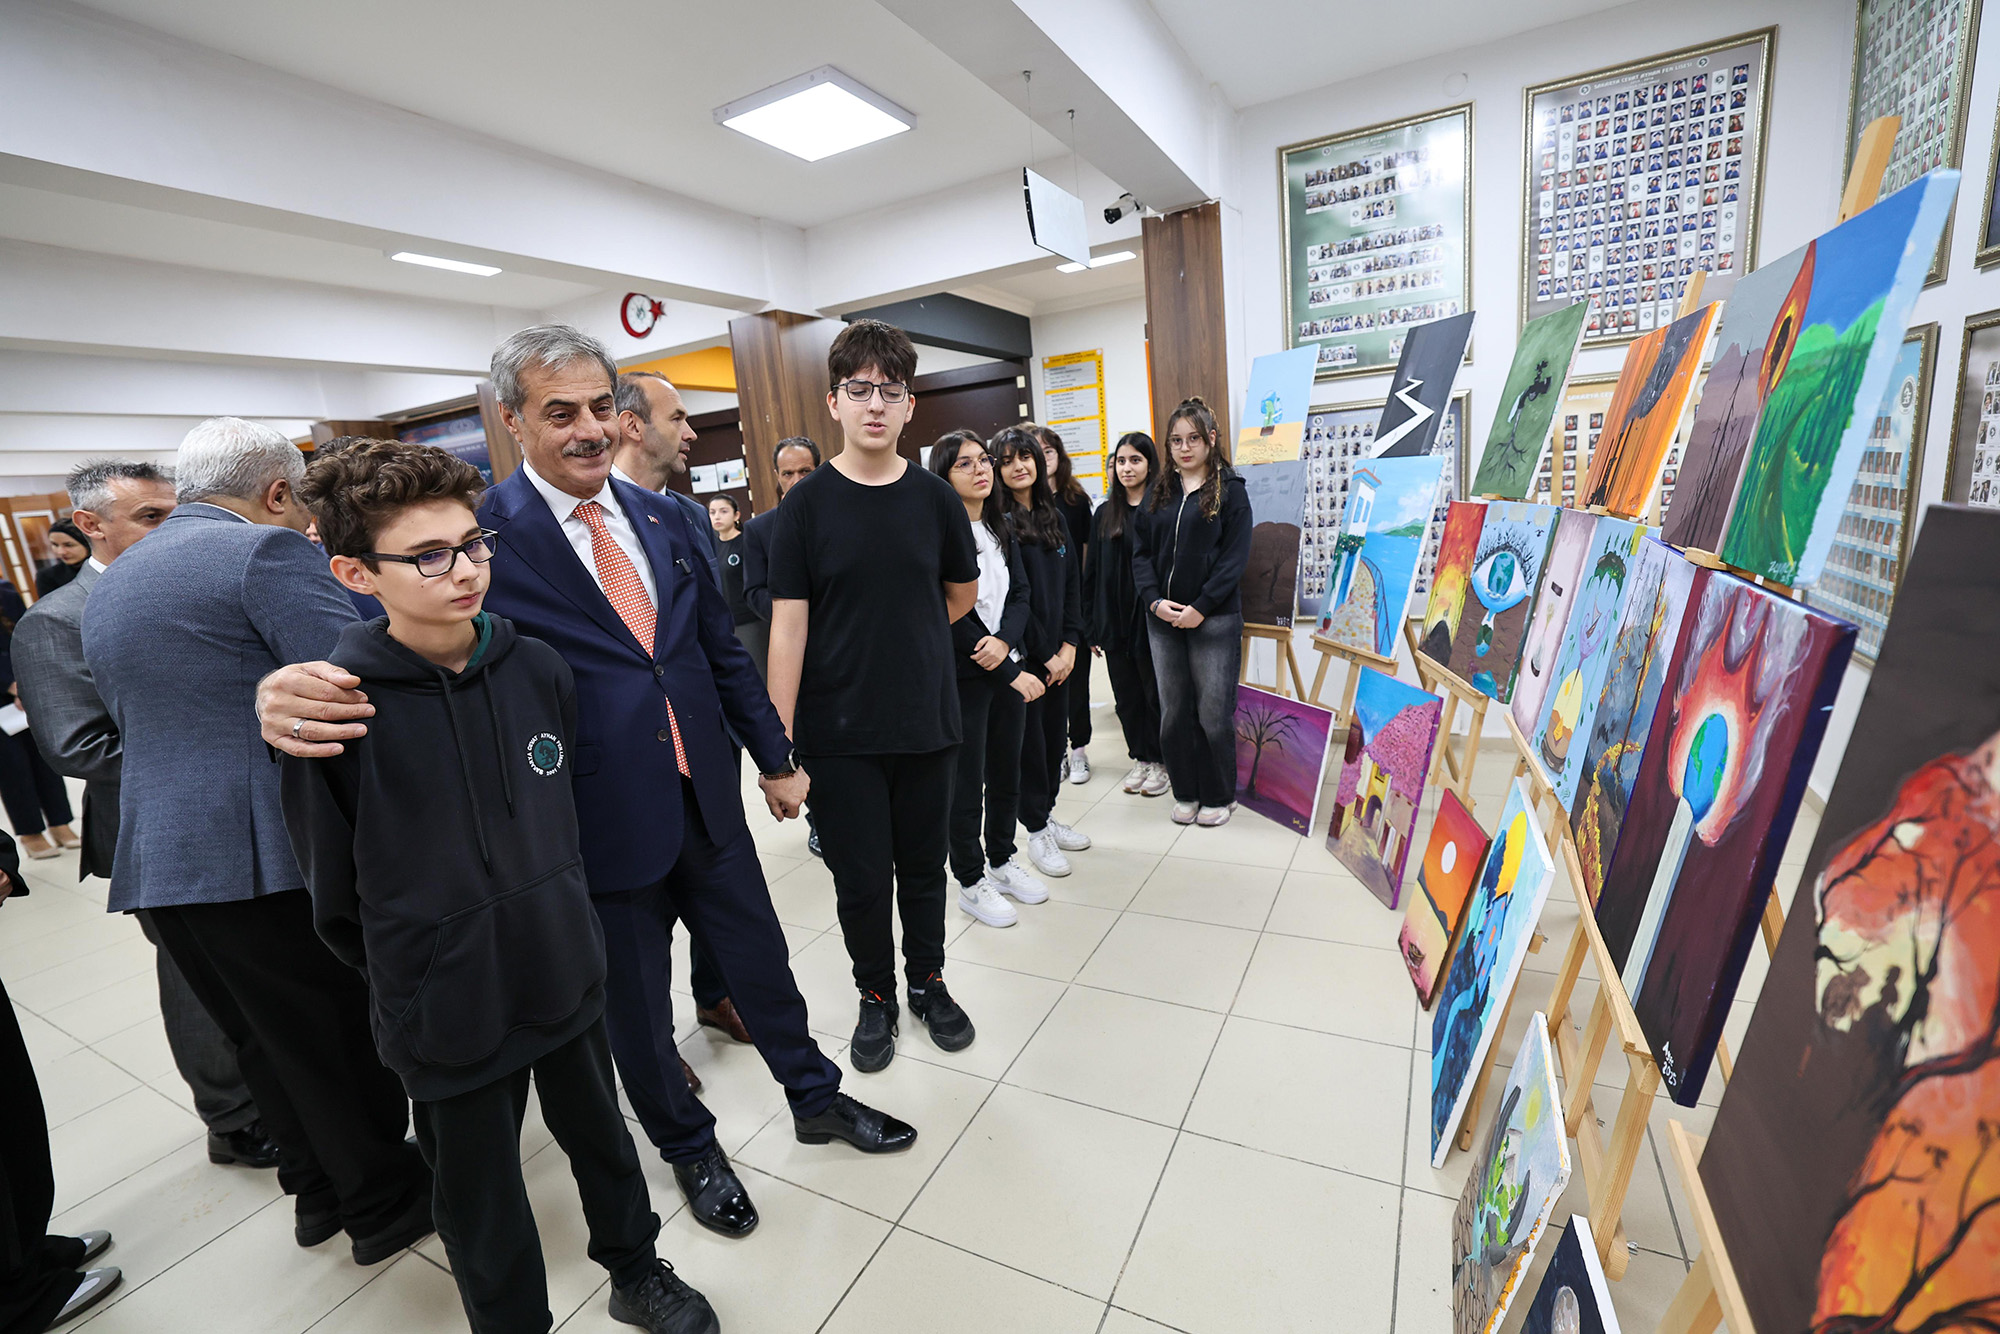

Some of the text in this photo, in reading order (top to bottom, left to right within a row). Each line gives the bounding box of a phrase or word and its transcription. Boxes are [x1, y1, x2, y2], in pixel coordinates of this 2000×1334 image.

[1594, 79, 1620, 89] SAKARYA
[1621, 74, 1640, 83] CEVAT
[1640, 69, 1661, 78] AYHAN
[1662, 66, 1674, 74] FEN
[527, 735, 538, 751] CEVAT
[541, 733, 557, 741] AYHAN
[527, 752, 544, 775] SAKARYA
